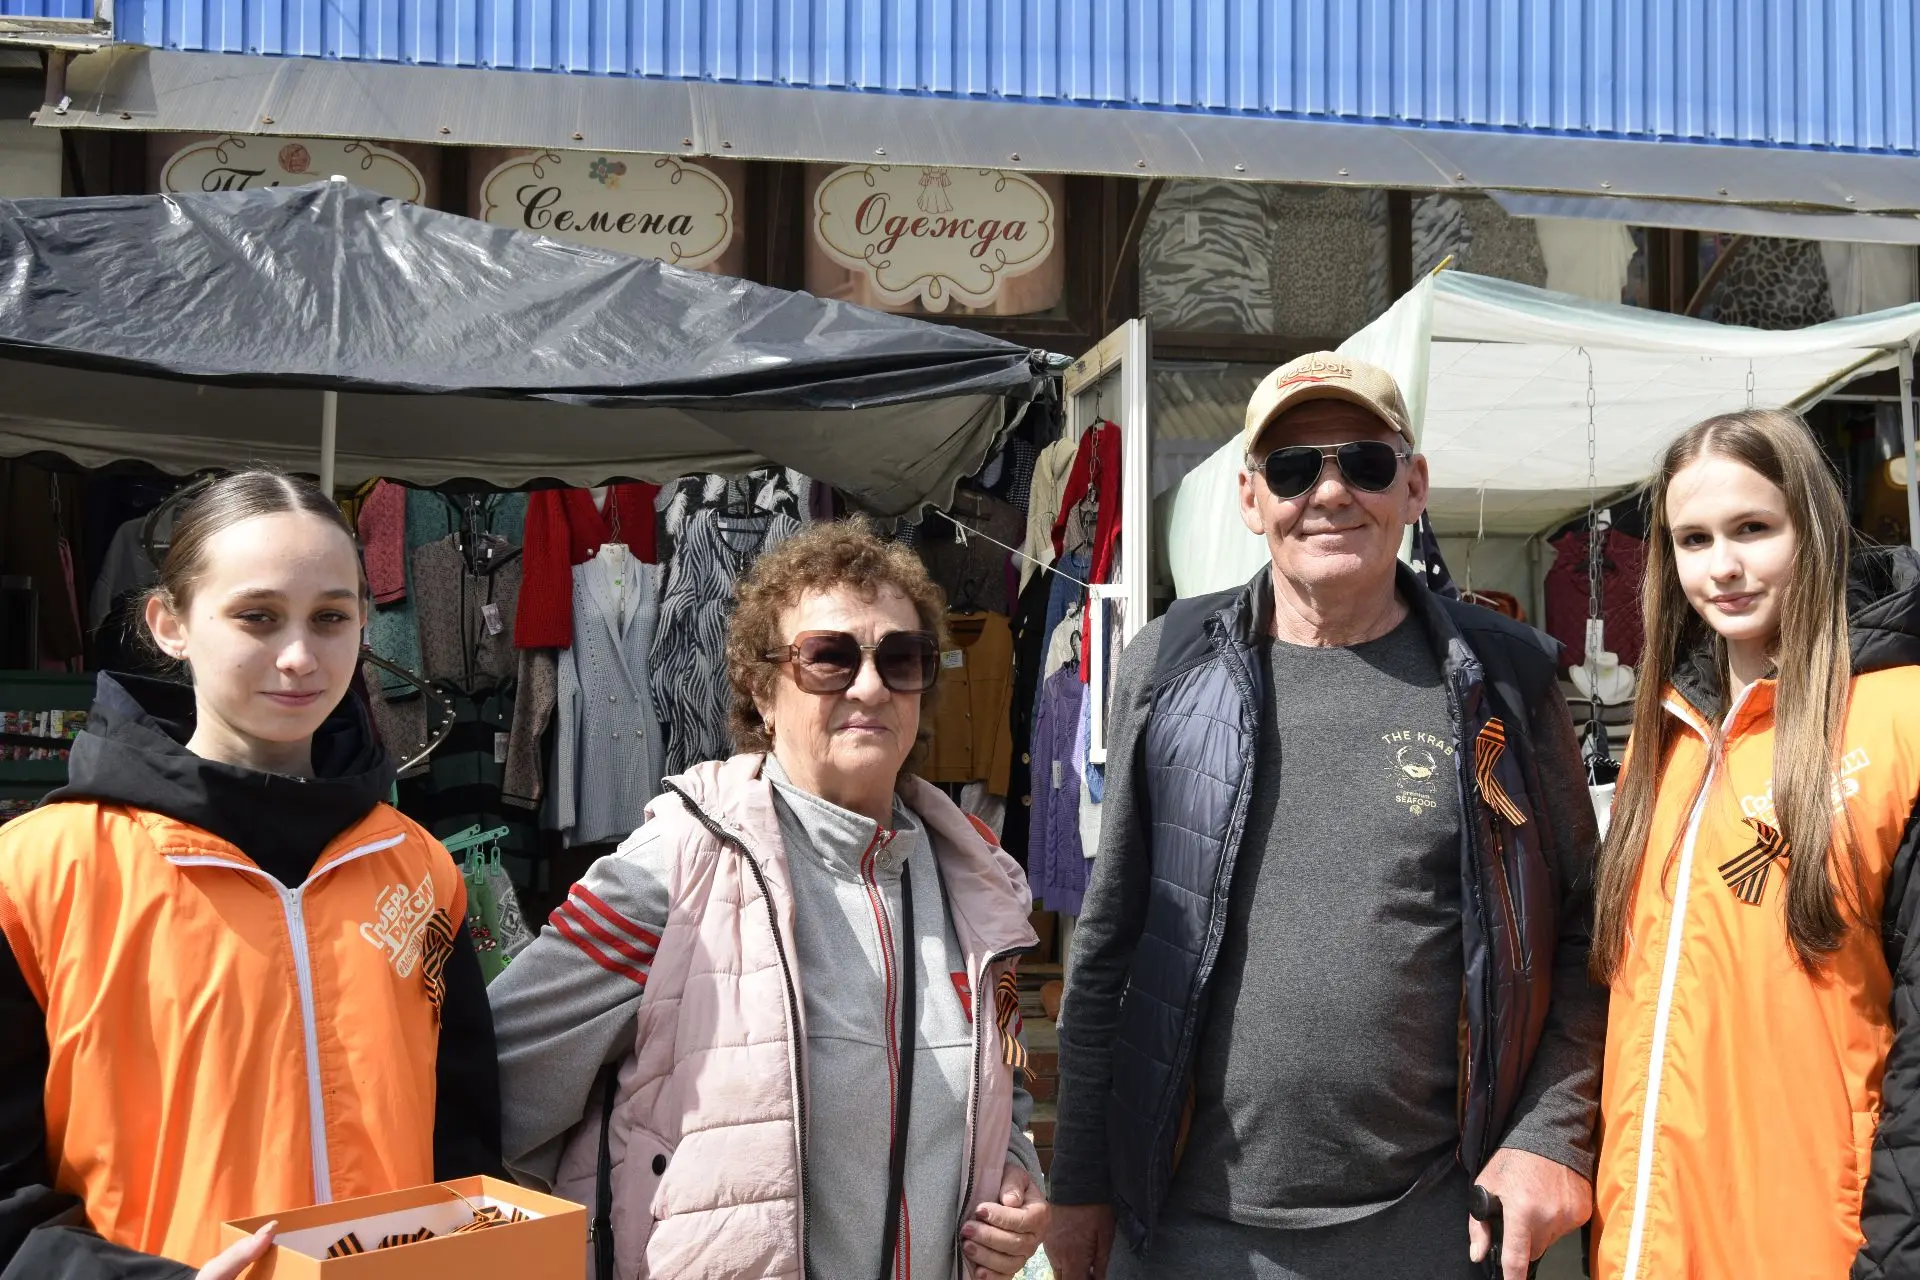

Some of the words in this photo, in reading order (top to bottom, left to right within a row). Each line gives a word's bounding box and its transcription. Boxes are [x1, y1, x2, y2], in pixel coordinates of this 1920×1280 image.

[516, 184, 694, 236] Семена
[855, 192, 1028, 258] Одежда
[1277, 356, 1352, 386] Reebok
[1382, 730, 1411, 744] THE
[1417, 732, 1454, 756] KRAB
[1395, 795, 1437, 808] SEAFOOD
